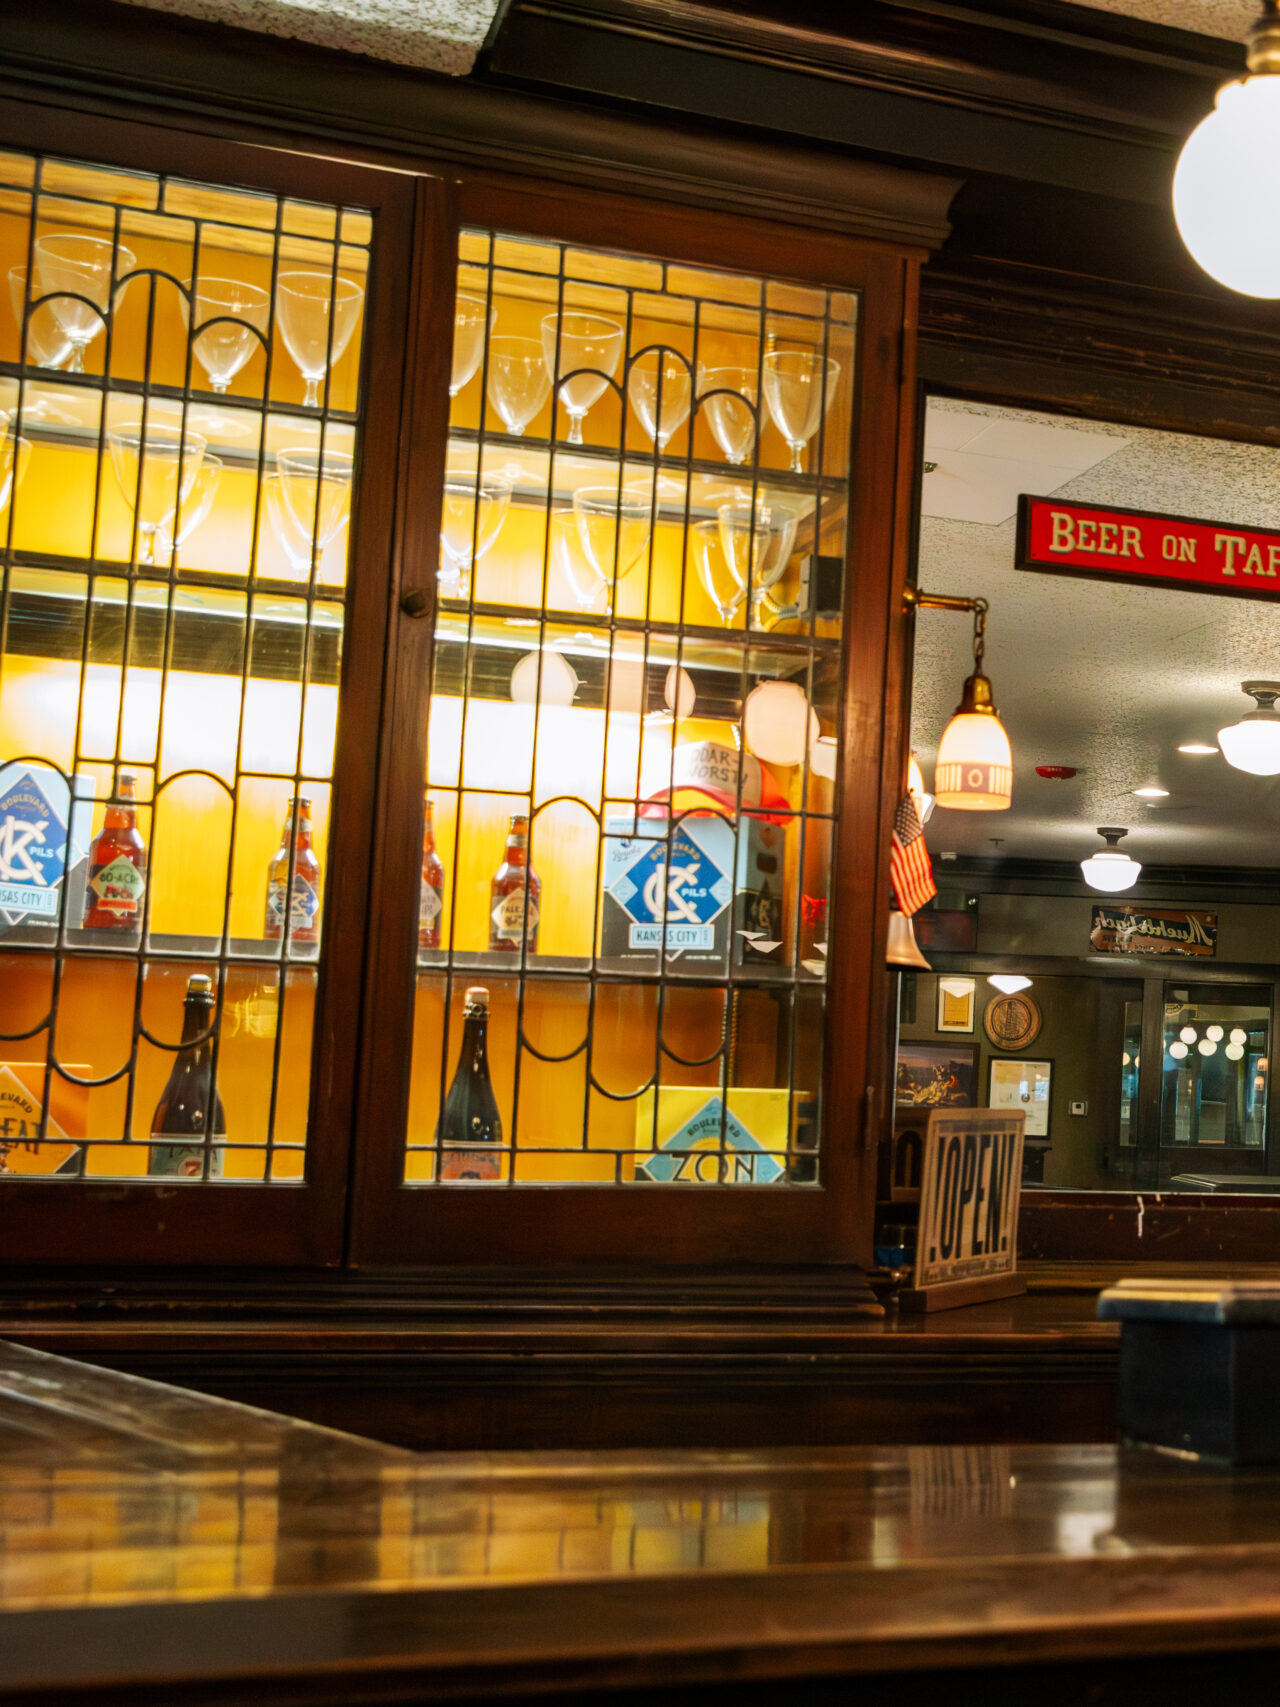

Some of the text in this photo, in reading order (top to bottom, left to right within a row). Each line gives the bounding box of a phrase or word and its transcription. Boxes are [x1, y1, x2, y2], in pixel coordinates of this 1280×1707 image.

[1049, 511, 1145, 560] BEER
[1162, 534, 1198, 564] ON
[1, 792, 50, 818] BOULEVARD
[29, 845, 55, 859] PILS
[650, 842, 701, 862] BOUEVARD
[0, 890, 19, 905] SAS
[21, 891, 43, 906] CITY
[643, 862, 708, 924] KC PILS
[636, 930, 674, 942] KANSS
[676, 930, 698, 942] CITY
[671, 1152, 755, 1183] ZON
